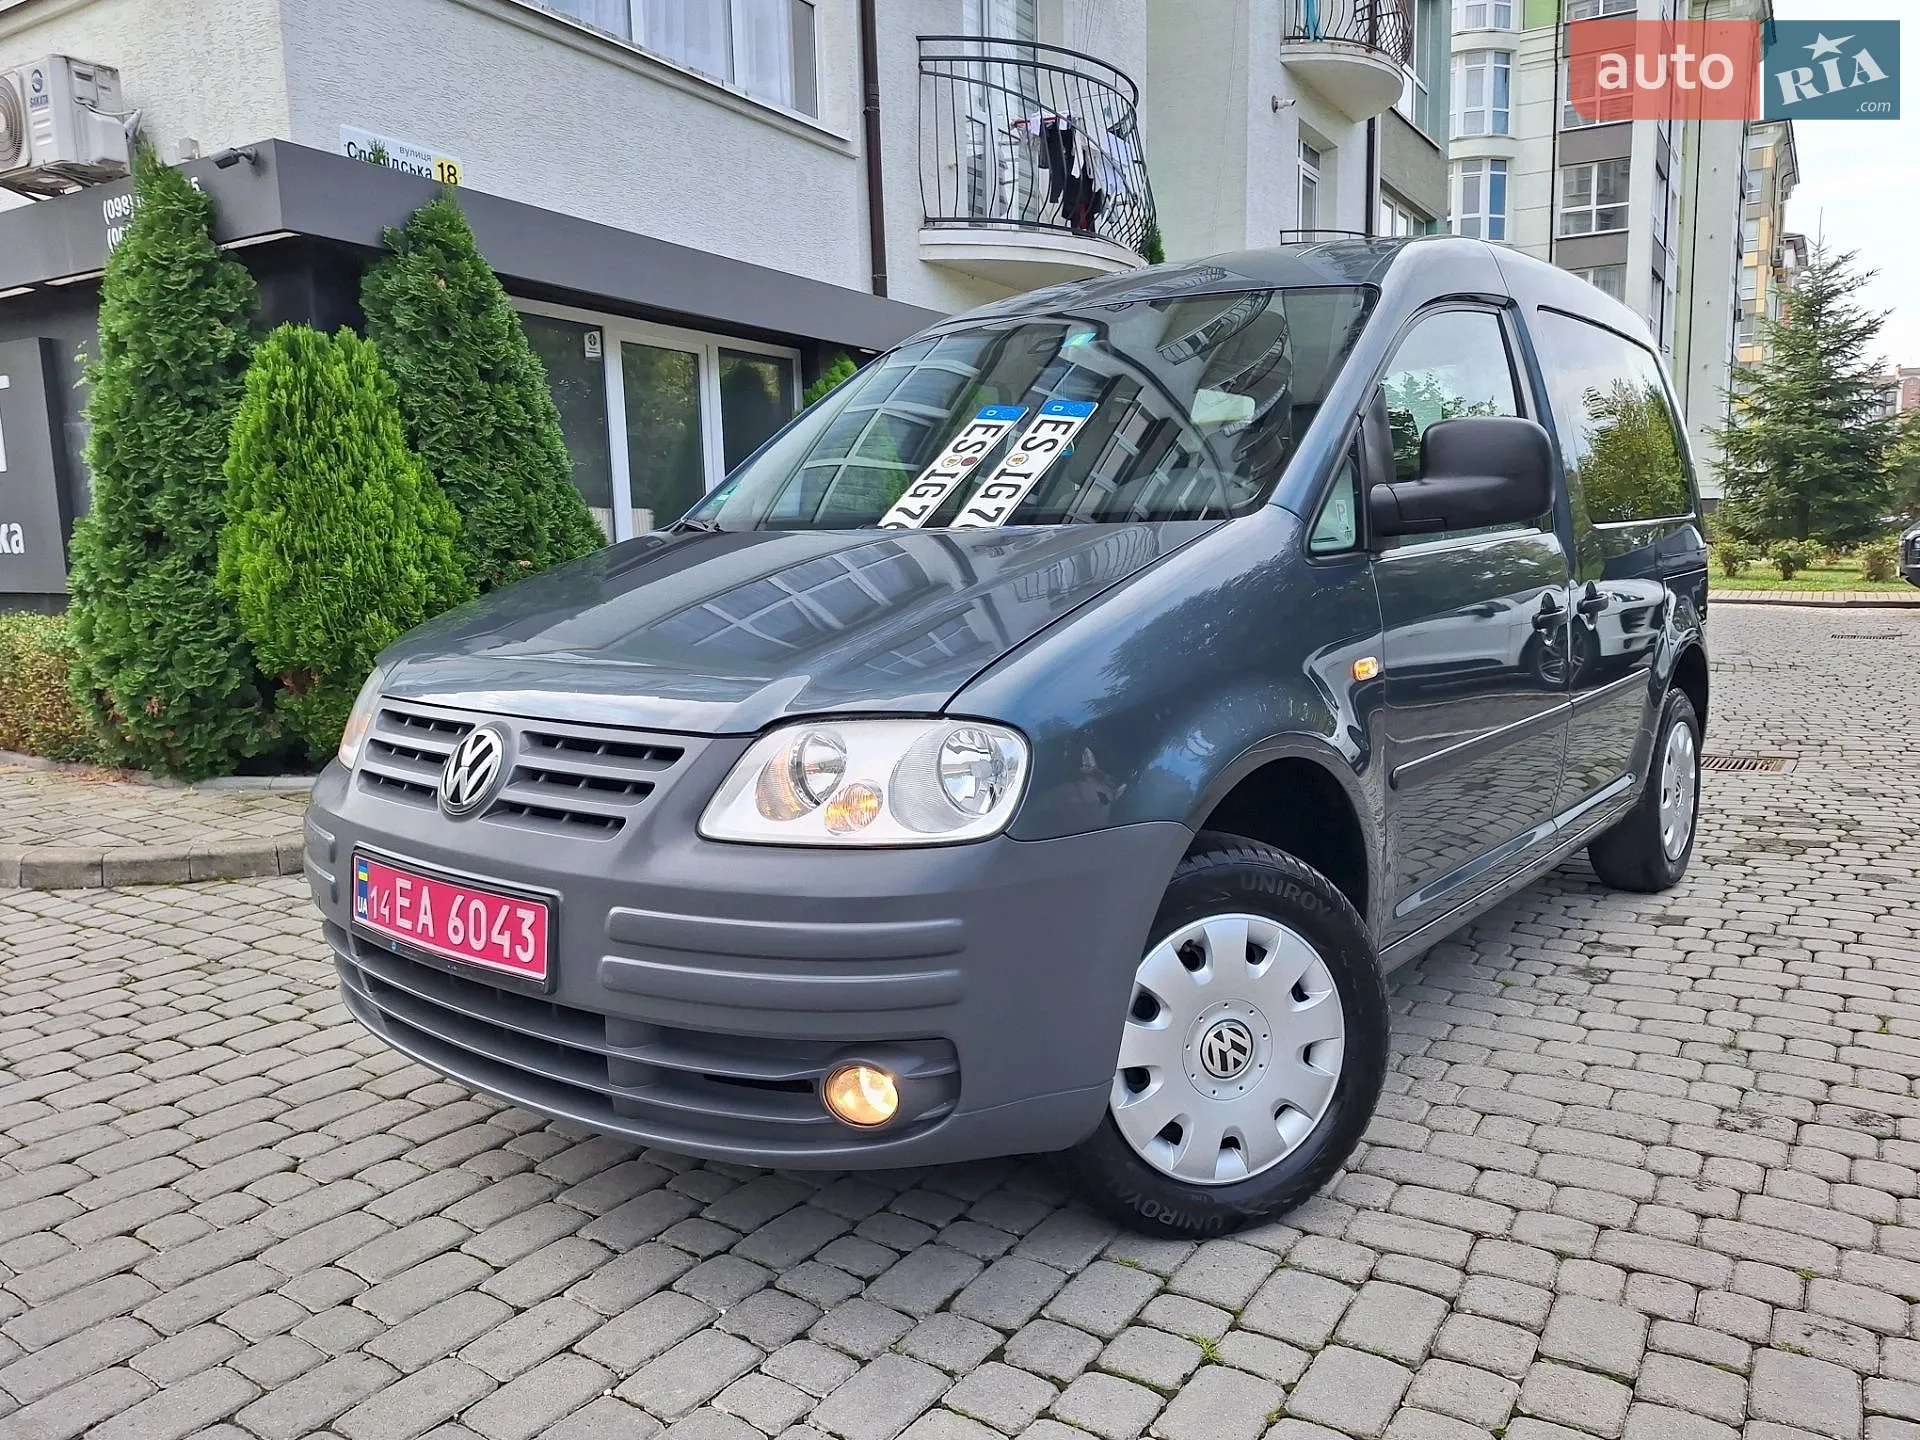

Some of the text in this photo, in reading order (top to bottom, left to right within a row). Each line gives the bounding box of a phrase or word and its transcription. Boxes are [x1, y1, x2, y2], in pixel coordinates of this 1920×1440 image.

[399, 146, 432, 162] вулиця
[437, 162, 458, 185] 18
[952, 424, 1004, 454] ES
[1021, 420, 1075, 452] ES
[357, 895, 368, 915] UA
[447, 894, 536, 963] 6043
